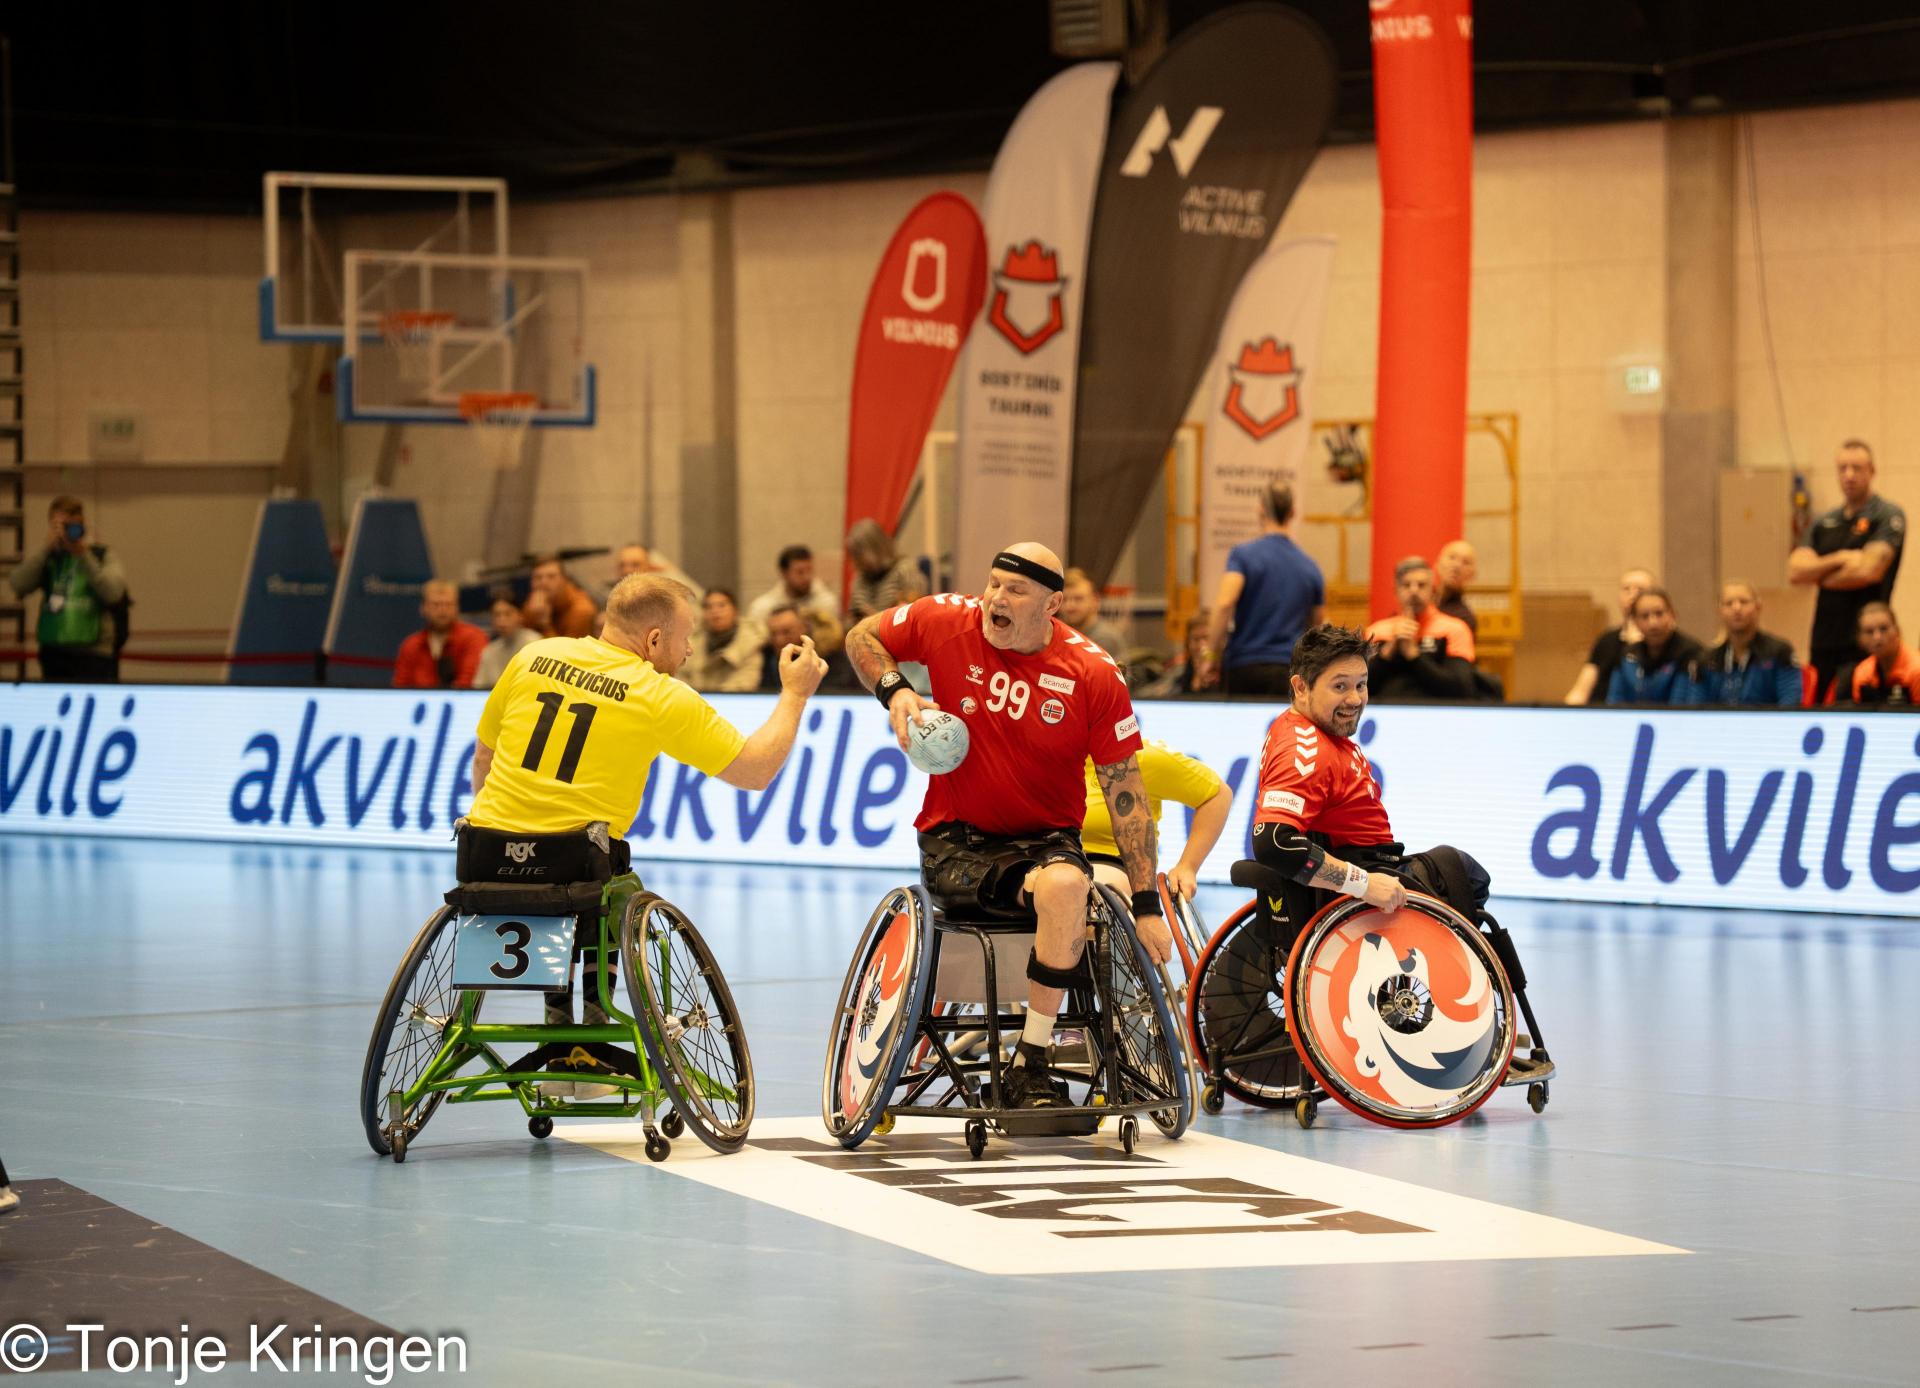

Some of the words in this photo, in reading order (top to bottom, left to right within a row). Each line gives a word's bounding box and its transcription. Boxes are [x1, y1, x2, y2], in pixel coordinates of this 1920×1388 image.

[1182, 186, 1265, 213] ACTIVE
[1179, 210, 1267, 239] VILNIUS
[882, 317, 959, 349] VILNIUS
[529, 656, 629, 702] BUTKEVIČIUS
[1042, 678, 1070, 690] Scandic
[985, 671, 1031, 720] 99
[521, 691, 598, 784] 11
[919, 714, 952, 740] SELECT
[1267, 794, 1300, 809] Scandic
[1531, 723, 1920, 894] akvilė
[497, 866, 549, 876] ELITE
[490, 921, 533, 980] 3
[746, 1133, 1437, 1239] SELECT
